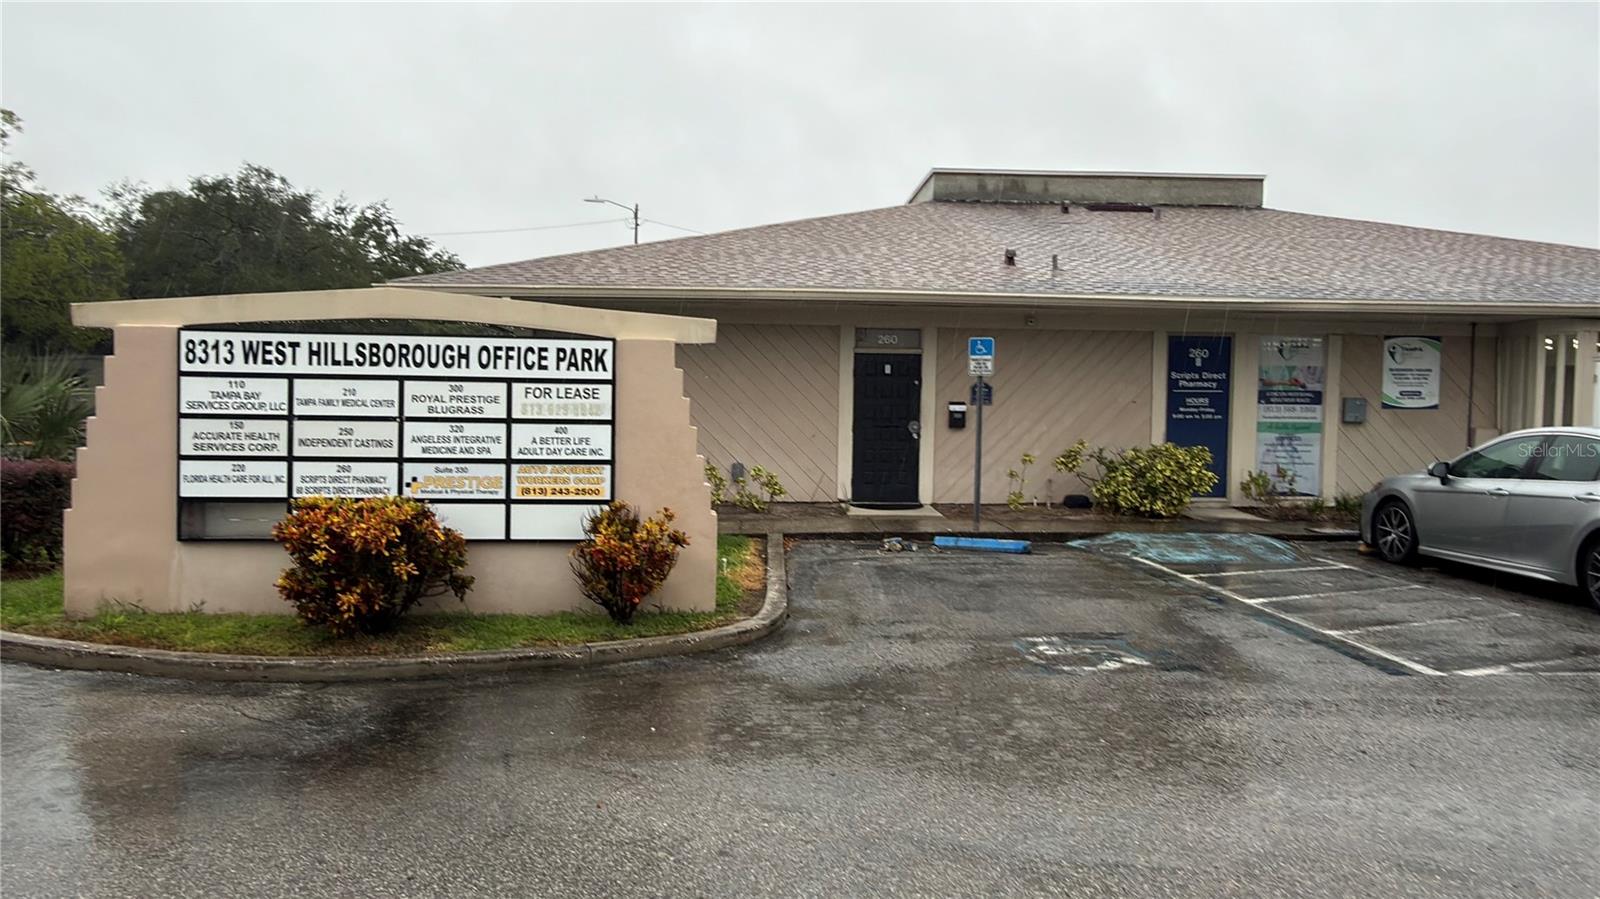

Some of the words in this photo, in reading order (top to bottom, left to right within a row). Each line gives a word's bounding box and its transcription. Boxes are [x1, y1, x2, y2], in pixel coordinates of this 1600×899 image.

[877, 335, 898, 345] 260
[185, 338, 235, 365] 8313
[241, 340, 300, 366] WEST
[308, 341, 470, 370] HILLSBOROUGH
[477, 345, 549, 371] OFFICE
[555, 347, 608, 373] PARK
[1188, 348, 1209, 358] 260
[1170, 371, 1200, 380] Scripts
[1201, 371, 1227, 380] Direct
[228, 380, 246, 389] 110
[448, 384, 464, 393] 300
[209, 391, 242, 400] TAMPA
[243, 391, 262, 401] BAY
[342, 388, 357, 397] 210
[524, 387, 552, 400] FOR
[556, 388, 600, 400] LEASE
[296, 398, 317, 406] TAMPA
[318, 398, 340, 407] FAMILY
[341, 399, 368, 408] MEDICAL
[370, 400, 396, 409] CENTER
[411, 394, 446, 404] ROYAL
[450, 395, 501, 405] PRESTIGE
[186, 400, 230, 410] SERVICES
[231, 401, 268, 412] GROUP,
[269, 402, 287, 411] LLC
[427, 406, 485, 416] BLUGRASS
[229, 421, 245, 430] 150
[448, 424, 465, 434] 320
[554, 426, 569, 435] 400
[192, 432, 242, 442] ACCURATE
[244, 433, 281, 442] HEALTH
[338, 427, 354, 437] 250
[298, 438, 353, 449] INDEPENDENT
[355, 439, 394, 449] CASTINGS
[410, 435, 452, 445] ANGELESS
[453, 436, 503, 446] INTEGRATIVE
[531, 437, 539, 446] A
[540, 437, 571, 446] BETTER
[573, 438, 591, 446] LIFE
[192, 443, 245, 452] SERVICES
[249, 443, 280, 453] CORP.
[421, 446, 457, 456] MEDICINE
[458, 446, 475, 456] AND
[476, 447, 491, 456] SPA
[517, 447, 543, 456] ADULT
[545, 448, 563, 457] DAY
[564, 448, 588, 457] CARE
[231, 463, 246, 473] 220
[434, 466, 453, 474] Suite
[517, 466, 548, 475] AUTO
[550, 466, 605, 475] ACCIDENT
[183, 474, 208, 483] FLORIDA
[209, 474, 231, 484] HEALTH
[232, 475, 249, 484] CARE
[249, 475, 261, 484] FOR
[300, 475, 327, 484] SCRIPTS
[328, 475, 350, 484] DIRECT
[352, 476, 387, 484] PHARMACY
[423, 476, 503, 489] PRESTIGE
[516, 476, 571, 485] WORKERS
[573, 477, 606, 486] COMP
[304, 487, 331, 495] SCRIPTS
[332, 487, 354, 495] DIRECT
[355, 487, 391, 496] PHARMACY
[521, 487, 547, 496] (813)
[550, 488, 601, 496] 243-2500
